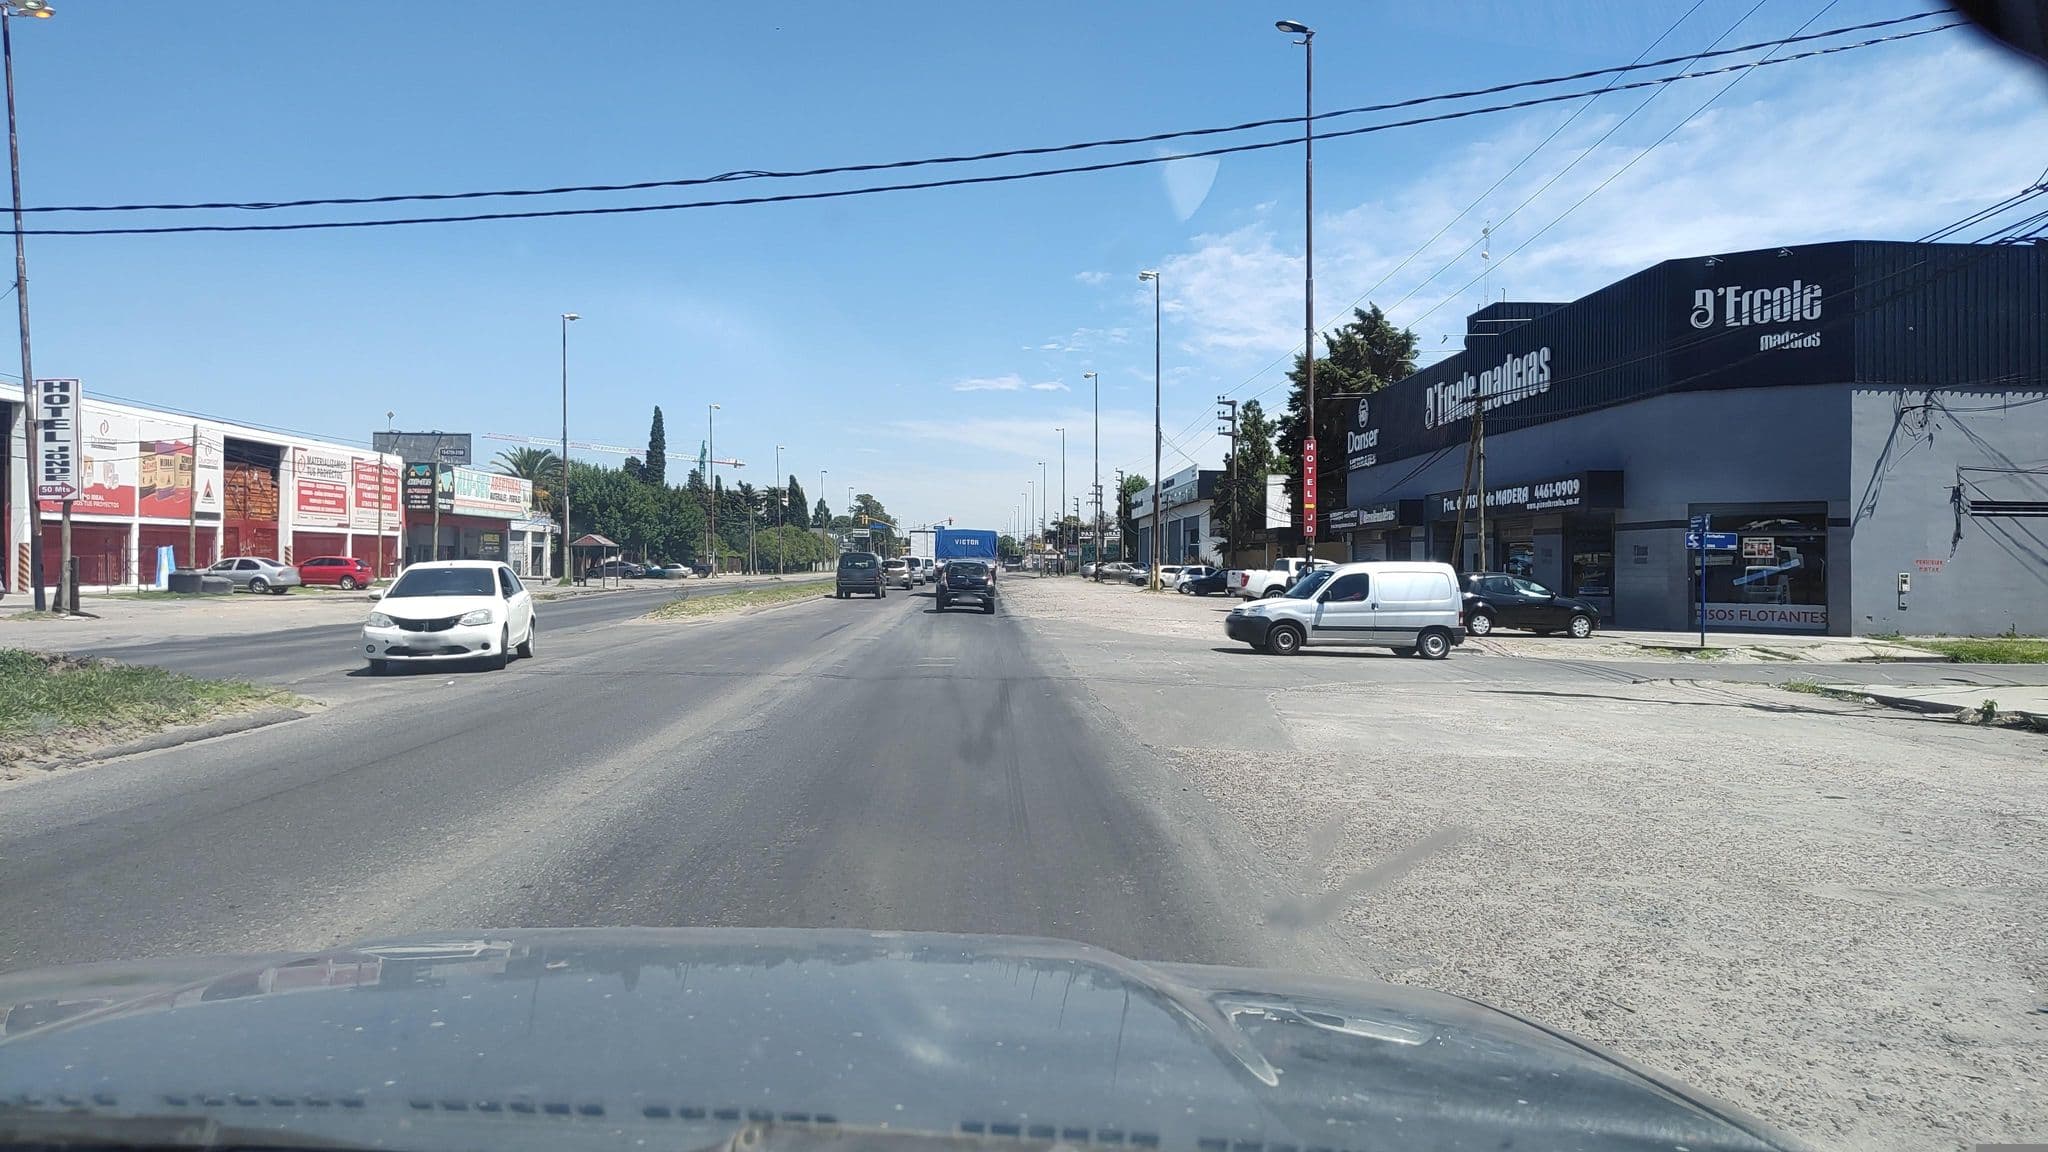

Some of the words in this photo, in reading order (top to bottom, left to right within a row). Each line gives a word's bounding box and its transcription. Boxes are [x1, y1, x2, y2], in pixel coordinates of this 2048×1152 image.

[1759, 331, 1821, 351] maderas
[1480, 347, 1552, 411] maderas
[43, 382, 71, 443] HOTEL
[1347, 429, 1380, 454] Danser
[1306, 443, 1314, 498] HOTEL
[1486, 492, 1495, 507] de
[1495, 486, 1530, 506] MADERA
[1534, 479, 1580, 499] 4461-0909
[1739, 609, 1828, 624] FLOTANTES
